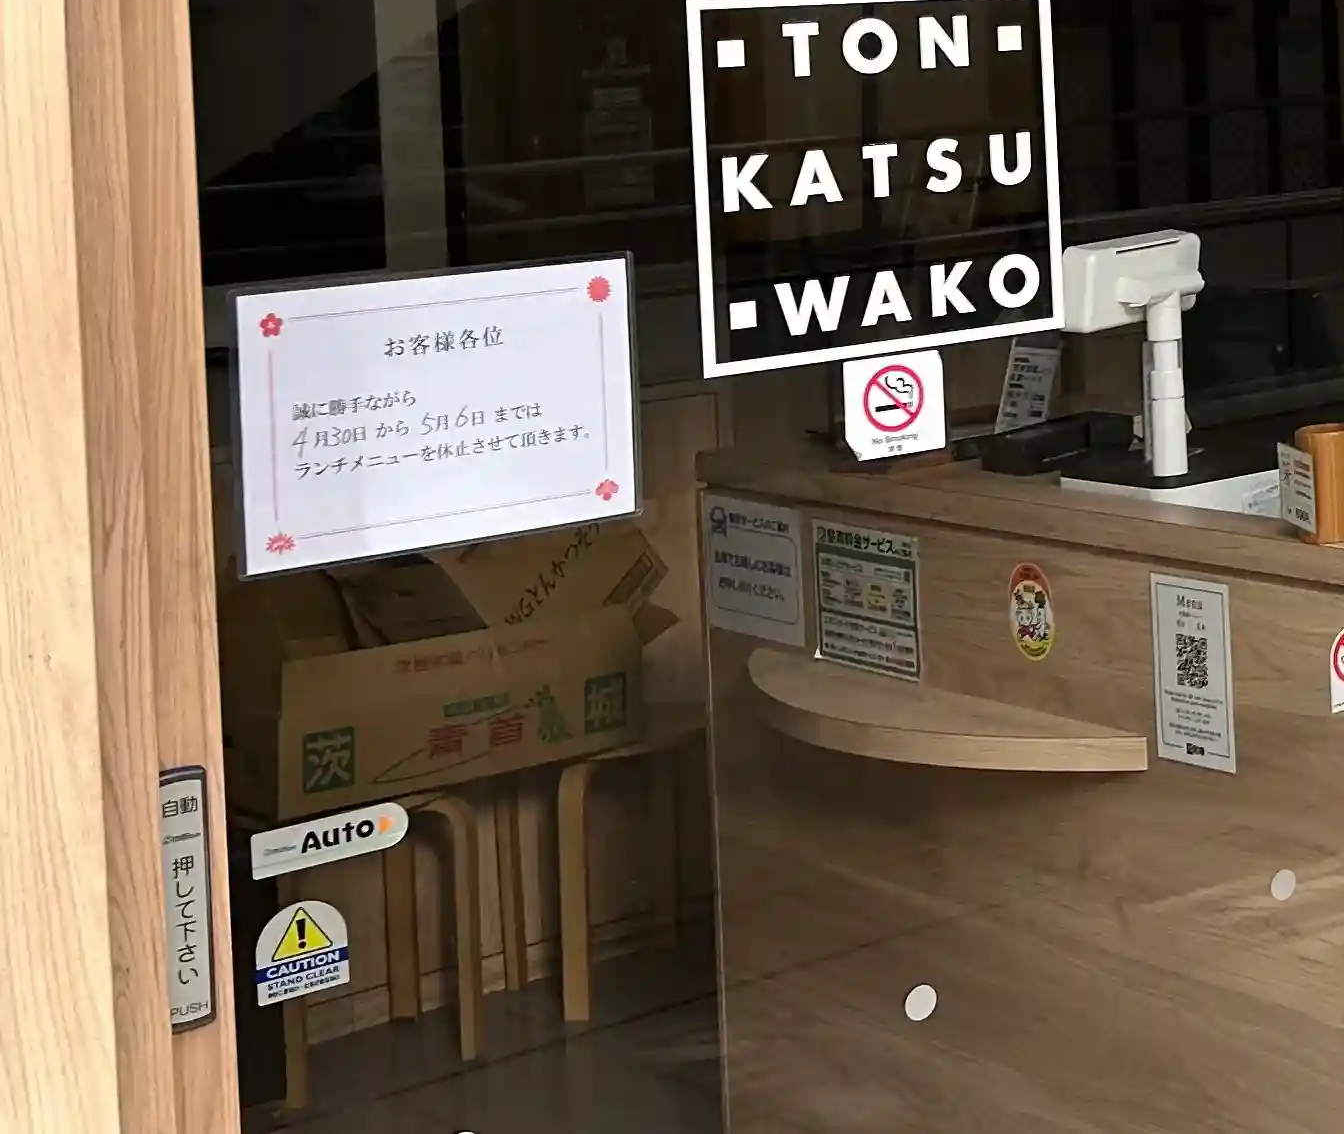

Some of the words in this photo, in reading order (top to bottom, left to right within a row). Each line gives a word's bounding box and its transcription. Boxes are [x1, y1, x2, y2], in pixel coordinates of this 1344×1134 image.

[782, 15, 970, 77] TON
[720, 131, 1033, 213] KATSU
[773, 253, 1040, 335] WAKO
[384, 325, 504, 358] お客様各位
[291, 390, 417, 421] 誠に勝手ながら
[375, 420, 411, 440] から
[494, 402, 543, 422] までは
[295, 424, 592, 479] ランチメニューを休止させて頂きます。
[306, 728, 353, 791] 茨
[162, 795, 198, 819] 自動
[301, 817, 374, 854] Auto
[171, 855, 199, 985] 押して下さい
[266, 951, 340, 979] CAUTION
[268, 975, 303, 991] STAND
[306, 965, 339, 980] CLEAR
